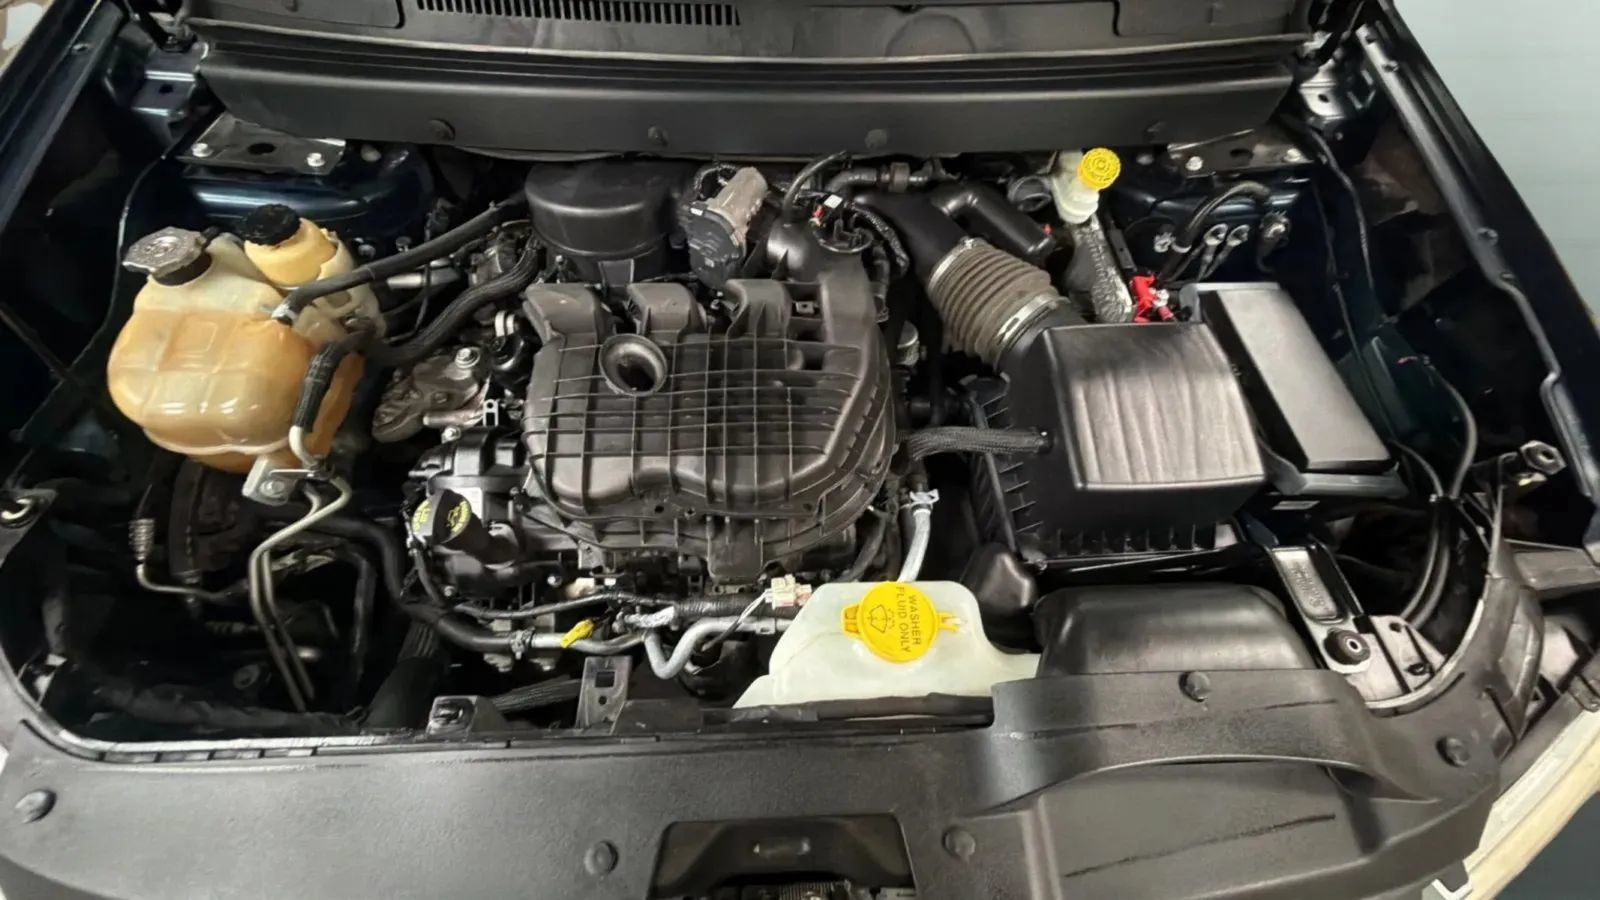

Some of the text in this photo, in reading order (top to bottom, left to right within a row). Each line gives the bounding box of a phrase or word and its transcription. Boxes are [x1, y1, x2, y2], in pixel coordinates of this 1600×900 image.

[895, 586, 912, 653] FLUID ONLY
[908, 594, 921, 646] WASHER
